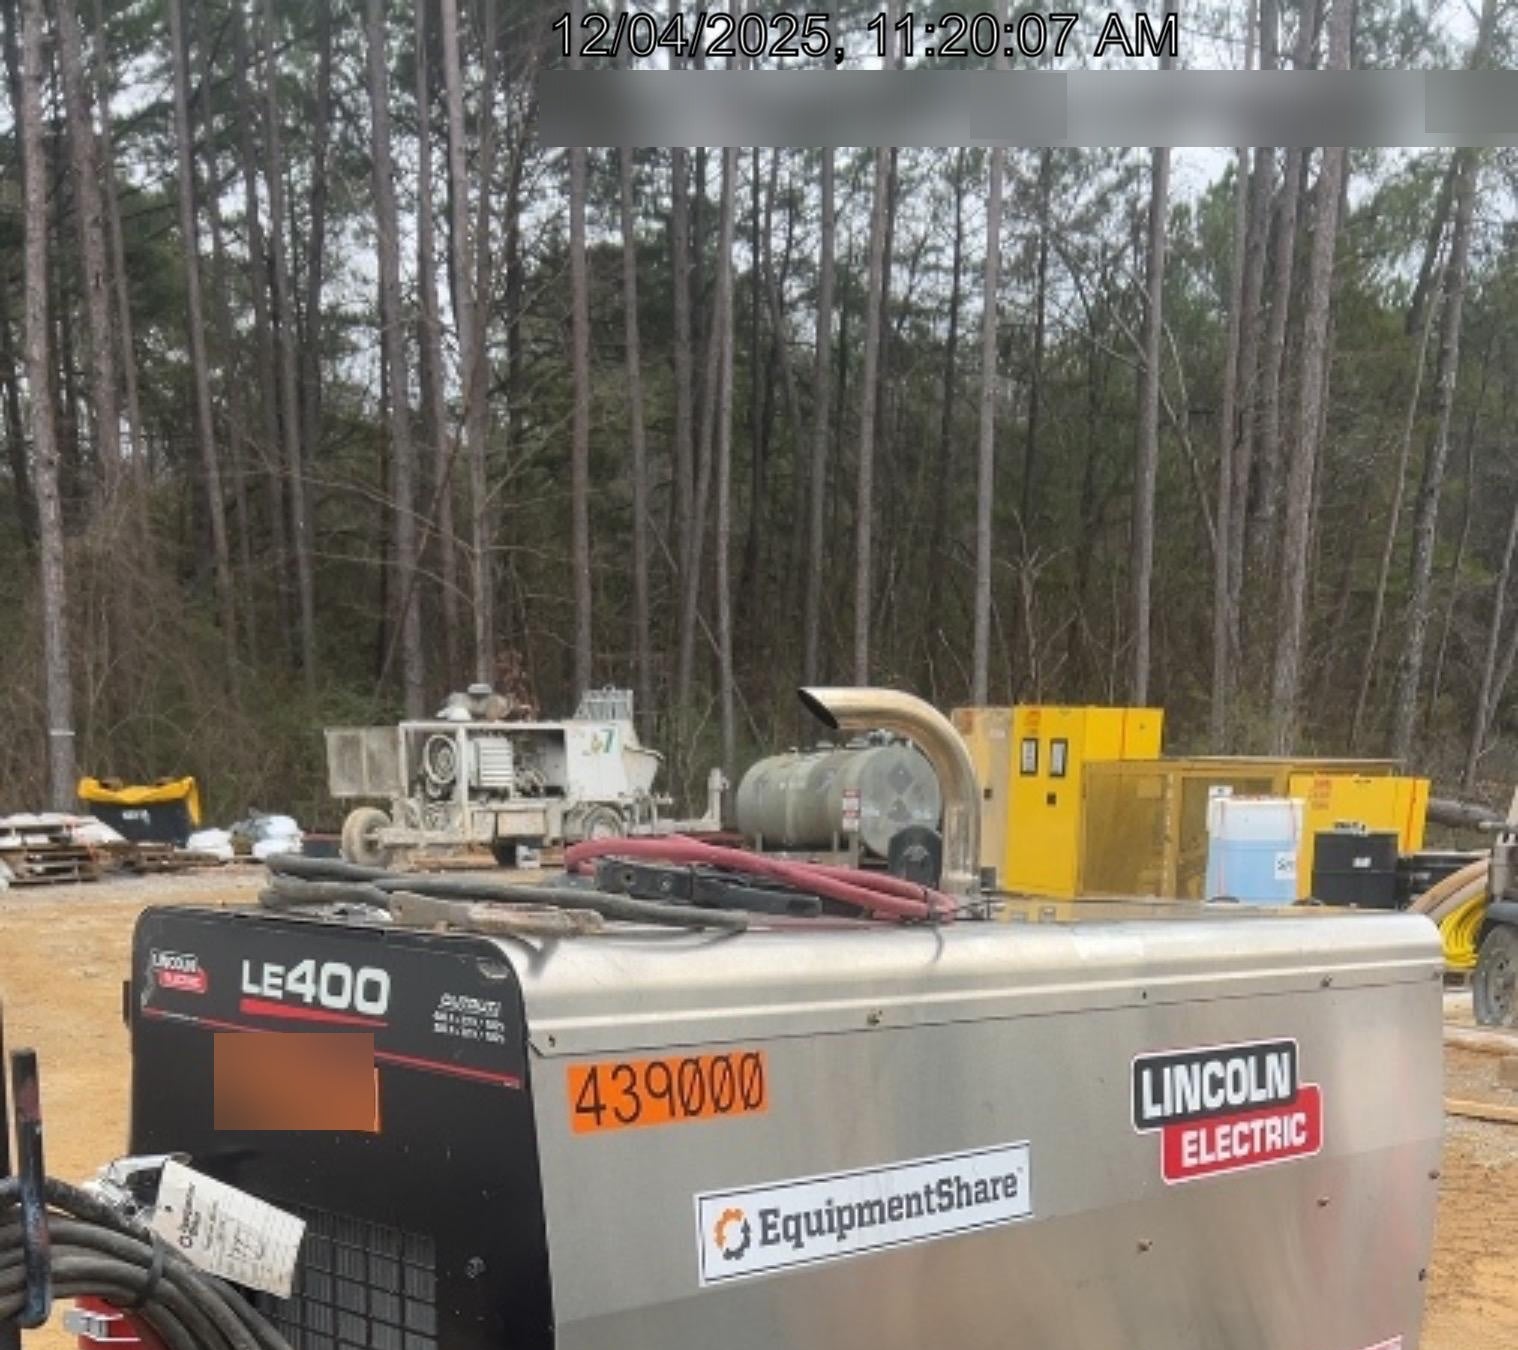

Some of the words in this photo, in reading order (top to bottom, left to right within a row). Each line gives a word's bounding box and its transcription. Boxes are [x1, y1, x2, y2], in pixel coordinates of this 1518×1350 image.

[241, 958, 391, 1016] LE400
[574, 1052, 764, 1126] 439000
[1142, 1052, 1291, 1120] LINCOLN
[1180, 1112, 1307, 1168] ELECTRIC
[758, 1170, 1019, 1248] EquipmentShare
